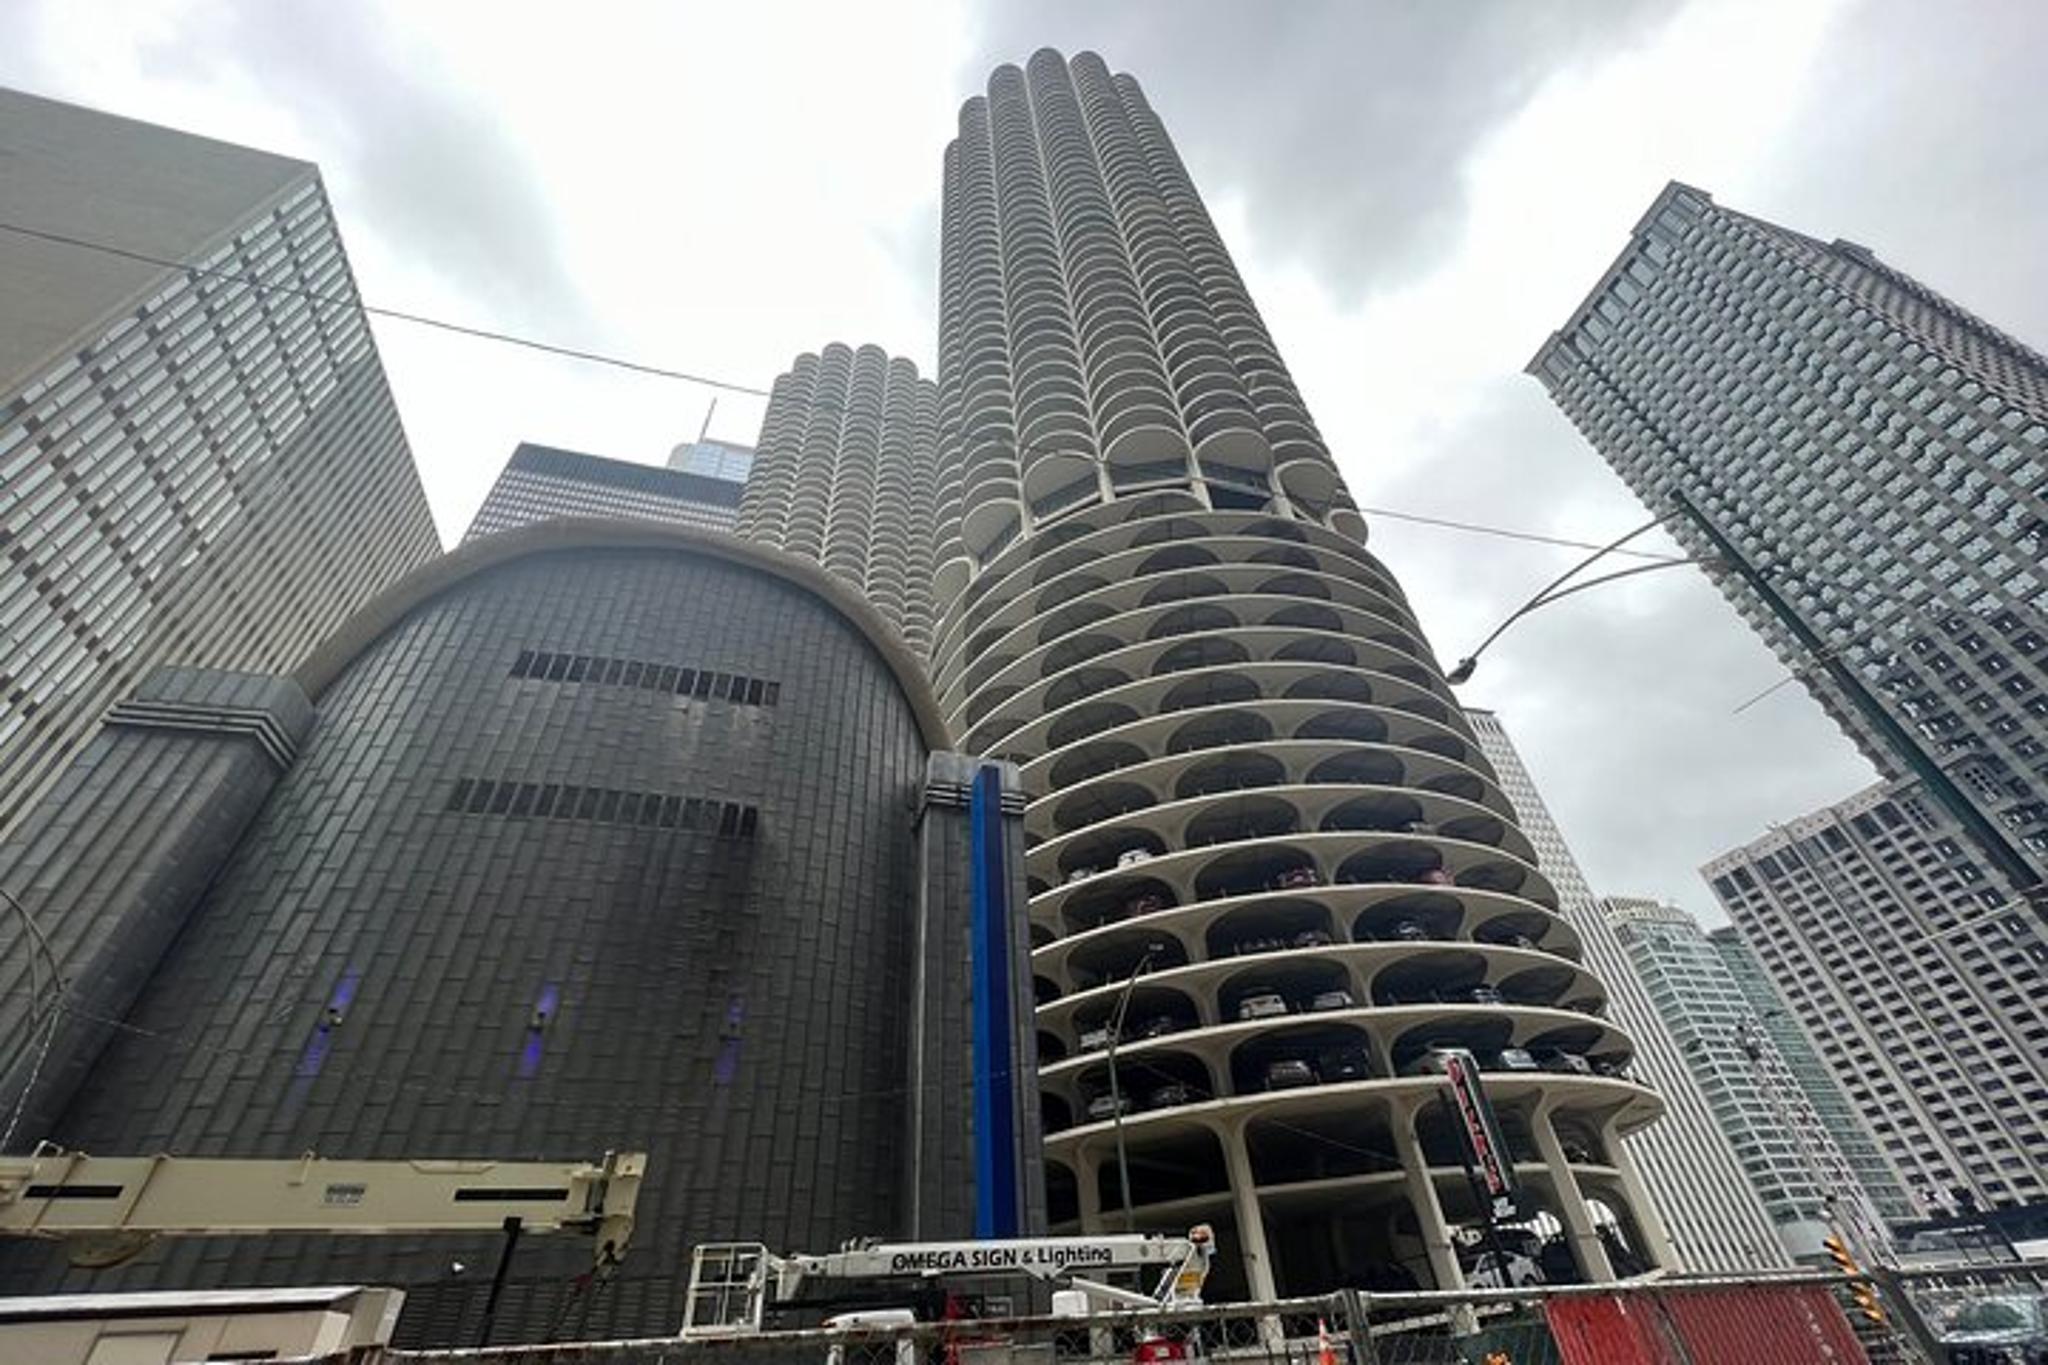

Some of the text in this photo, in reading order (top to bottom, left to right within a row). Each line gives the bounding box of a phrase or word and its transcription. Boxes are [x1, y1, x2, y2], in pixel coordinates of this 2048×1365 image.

[892, 1251, 966, 1270] OMEGA
[972, 1248, 1016, 1266] SIGN
[1038, 1246, 1113, 1267] Lighting
